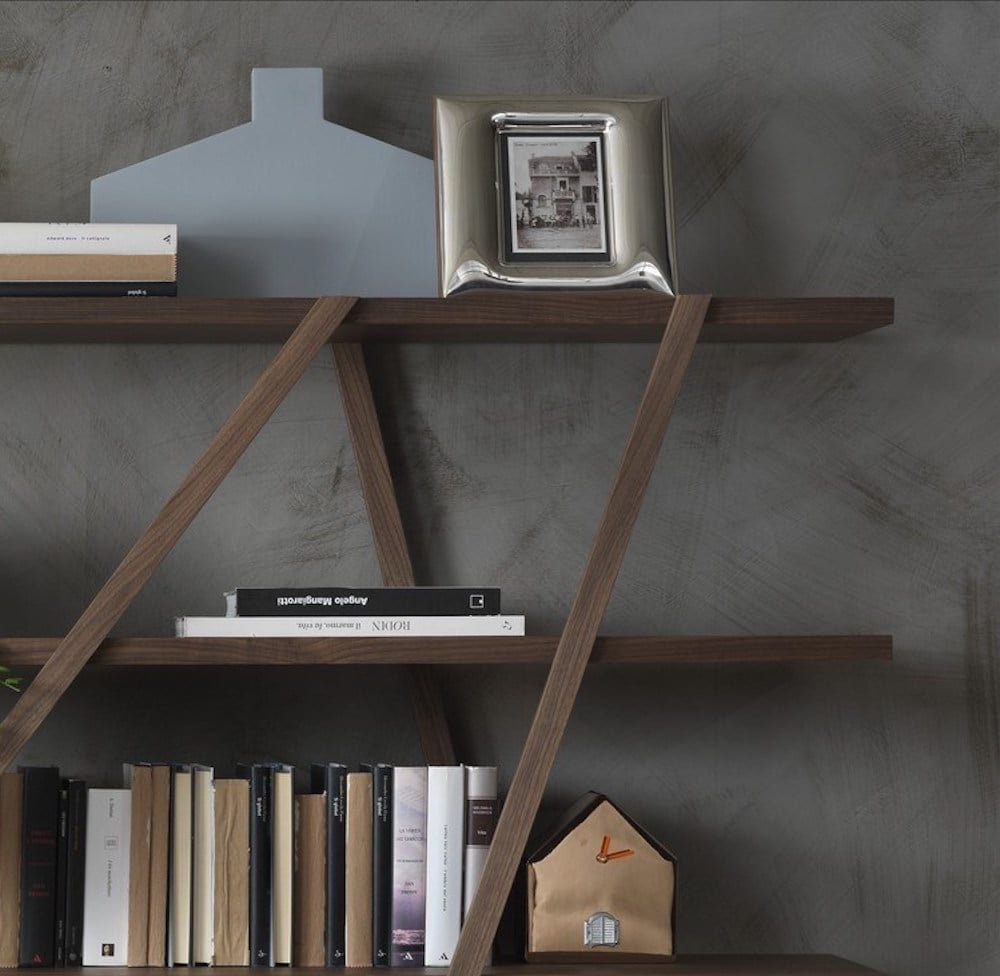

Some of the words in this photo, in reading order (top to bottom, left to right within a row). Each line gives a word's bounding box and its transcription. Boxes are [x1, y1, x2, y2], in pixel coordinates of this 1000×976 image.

[277, 596, 332, 607] Mangiarotti
[334, 596, 368, 607] Angelo
[371, 620, 411, 631] RODIN
